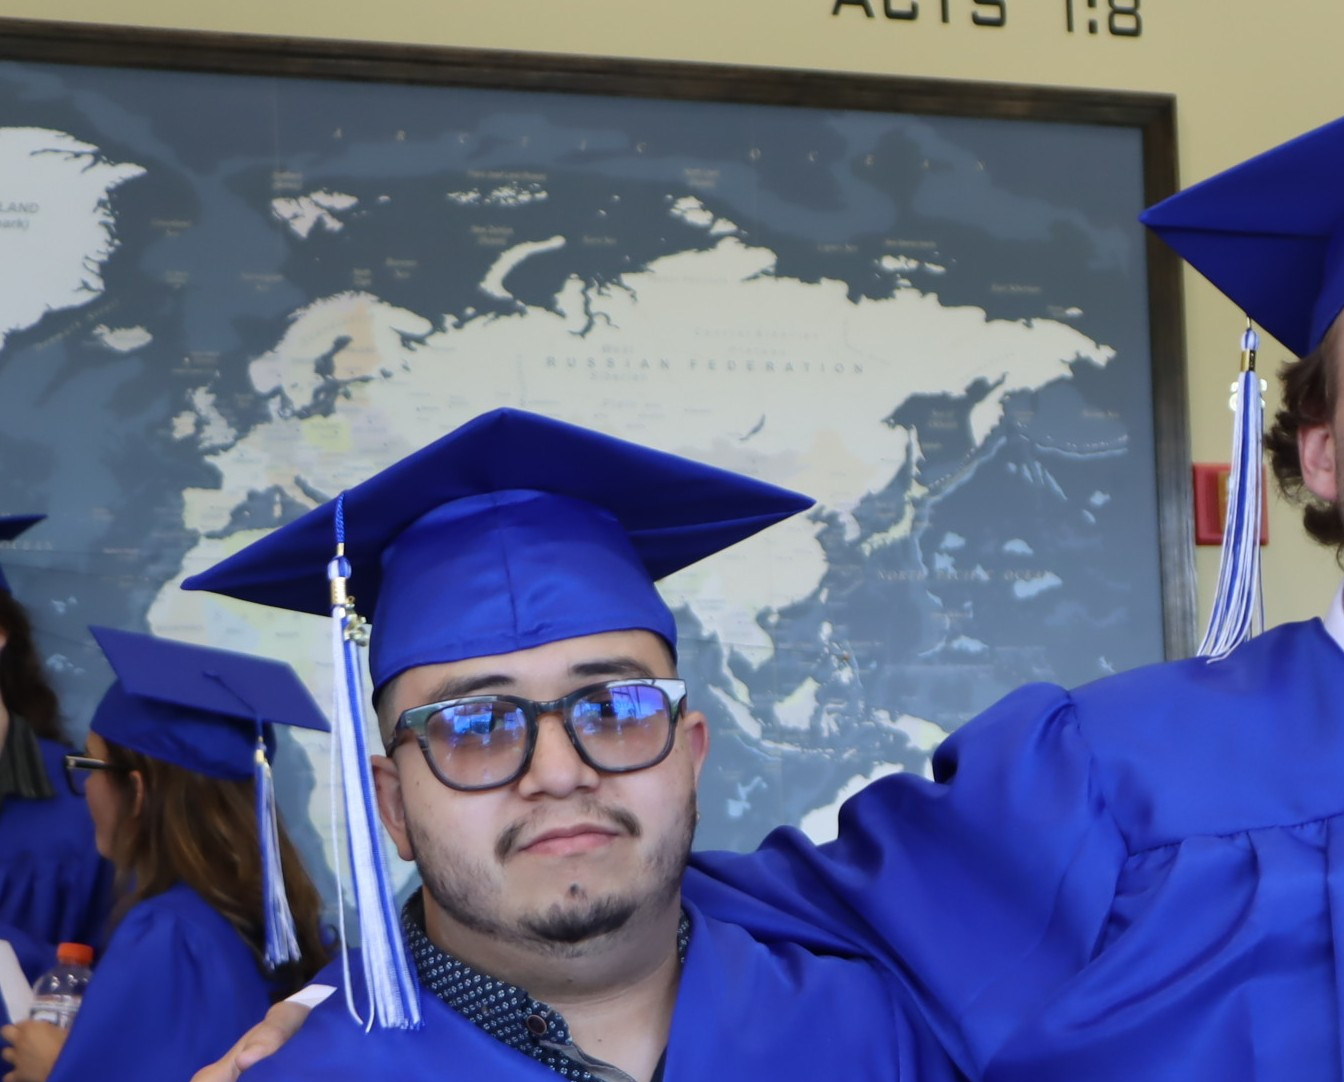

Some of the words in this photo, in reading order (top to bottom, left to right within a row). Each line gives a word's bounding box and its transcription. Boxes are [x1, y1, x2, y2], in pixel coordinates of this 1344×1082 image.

[1064, 0, 1142, 37] 1:8
[545, 355, 671, 370] RUSSIAN
[689, 357, 865, 374] FEDERATION
